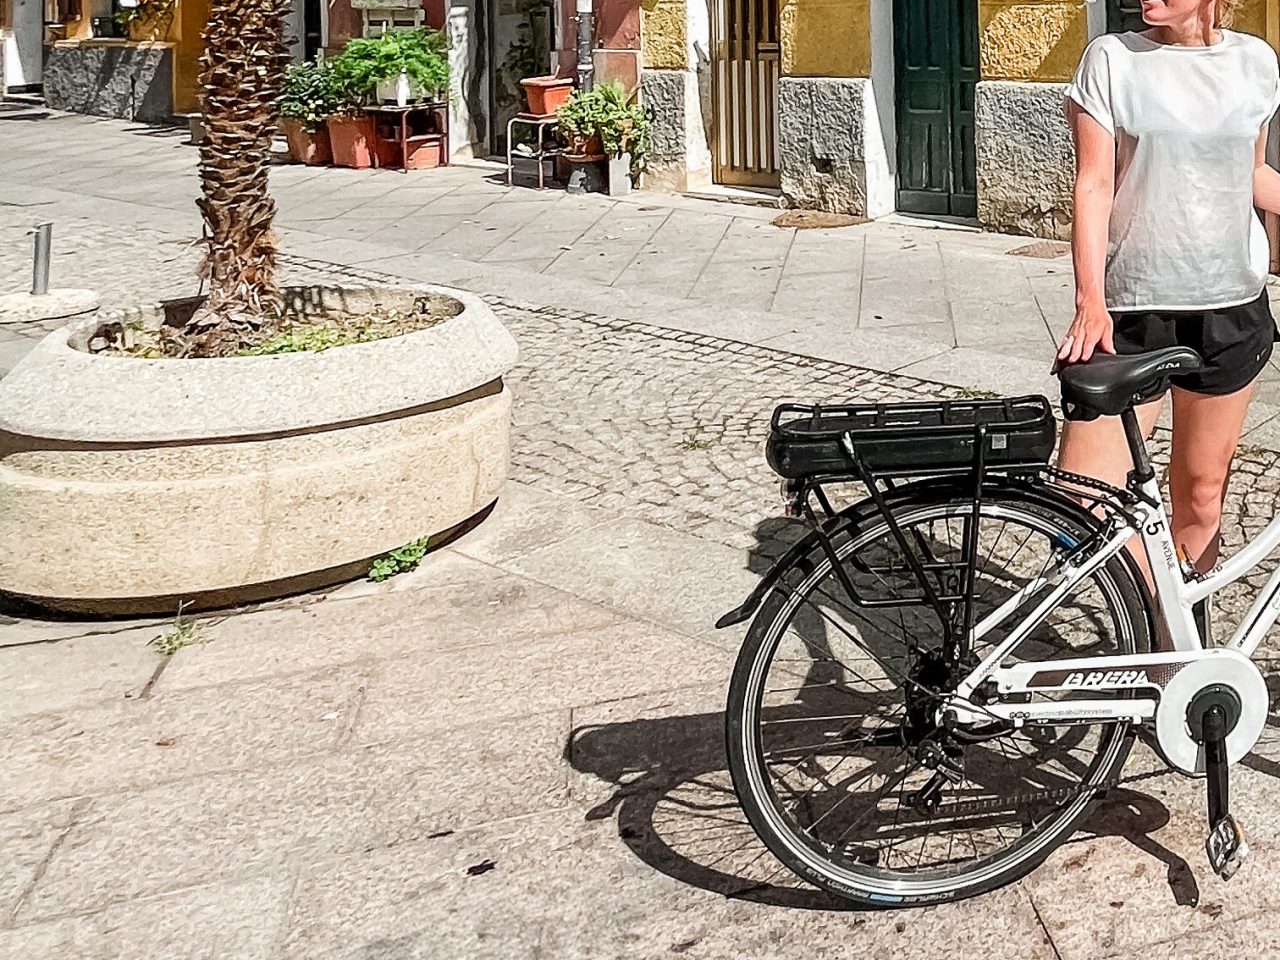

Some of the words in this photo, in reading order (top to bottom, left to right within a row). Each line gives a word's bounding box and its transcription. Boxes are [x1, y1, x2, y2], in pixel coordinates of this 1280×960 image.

[1145, 519, 1166, 536] 5
[1160, 539, 1176, 571] AVENUE
[1061, 670, 1149, 687] BRERA
